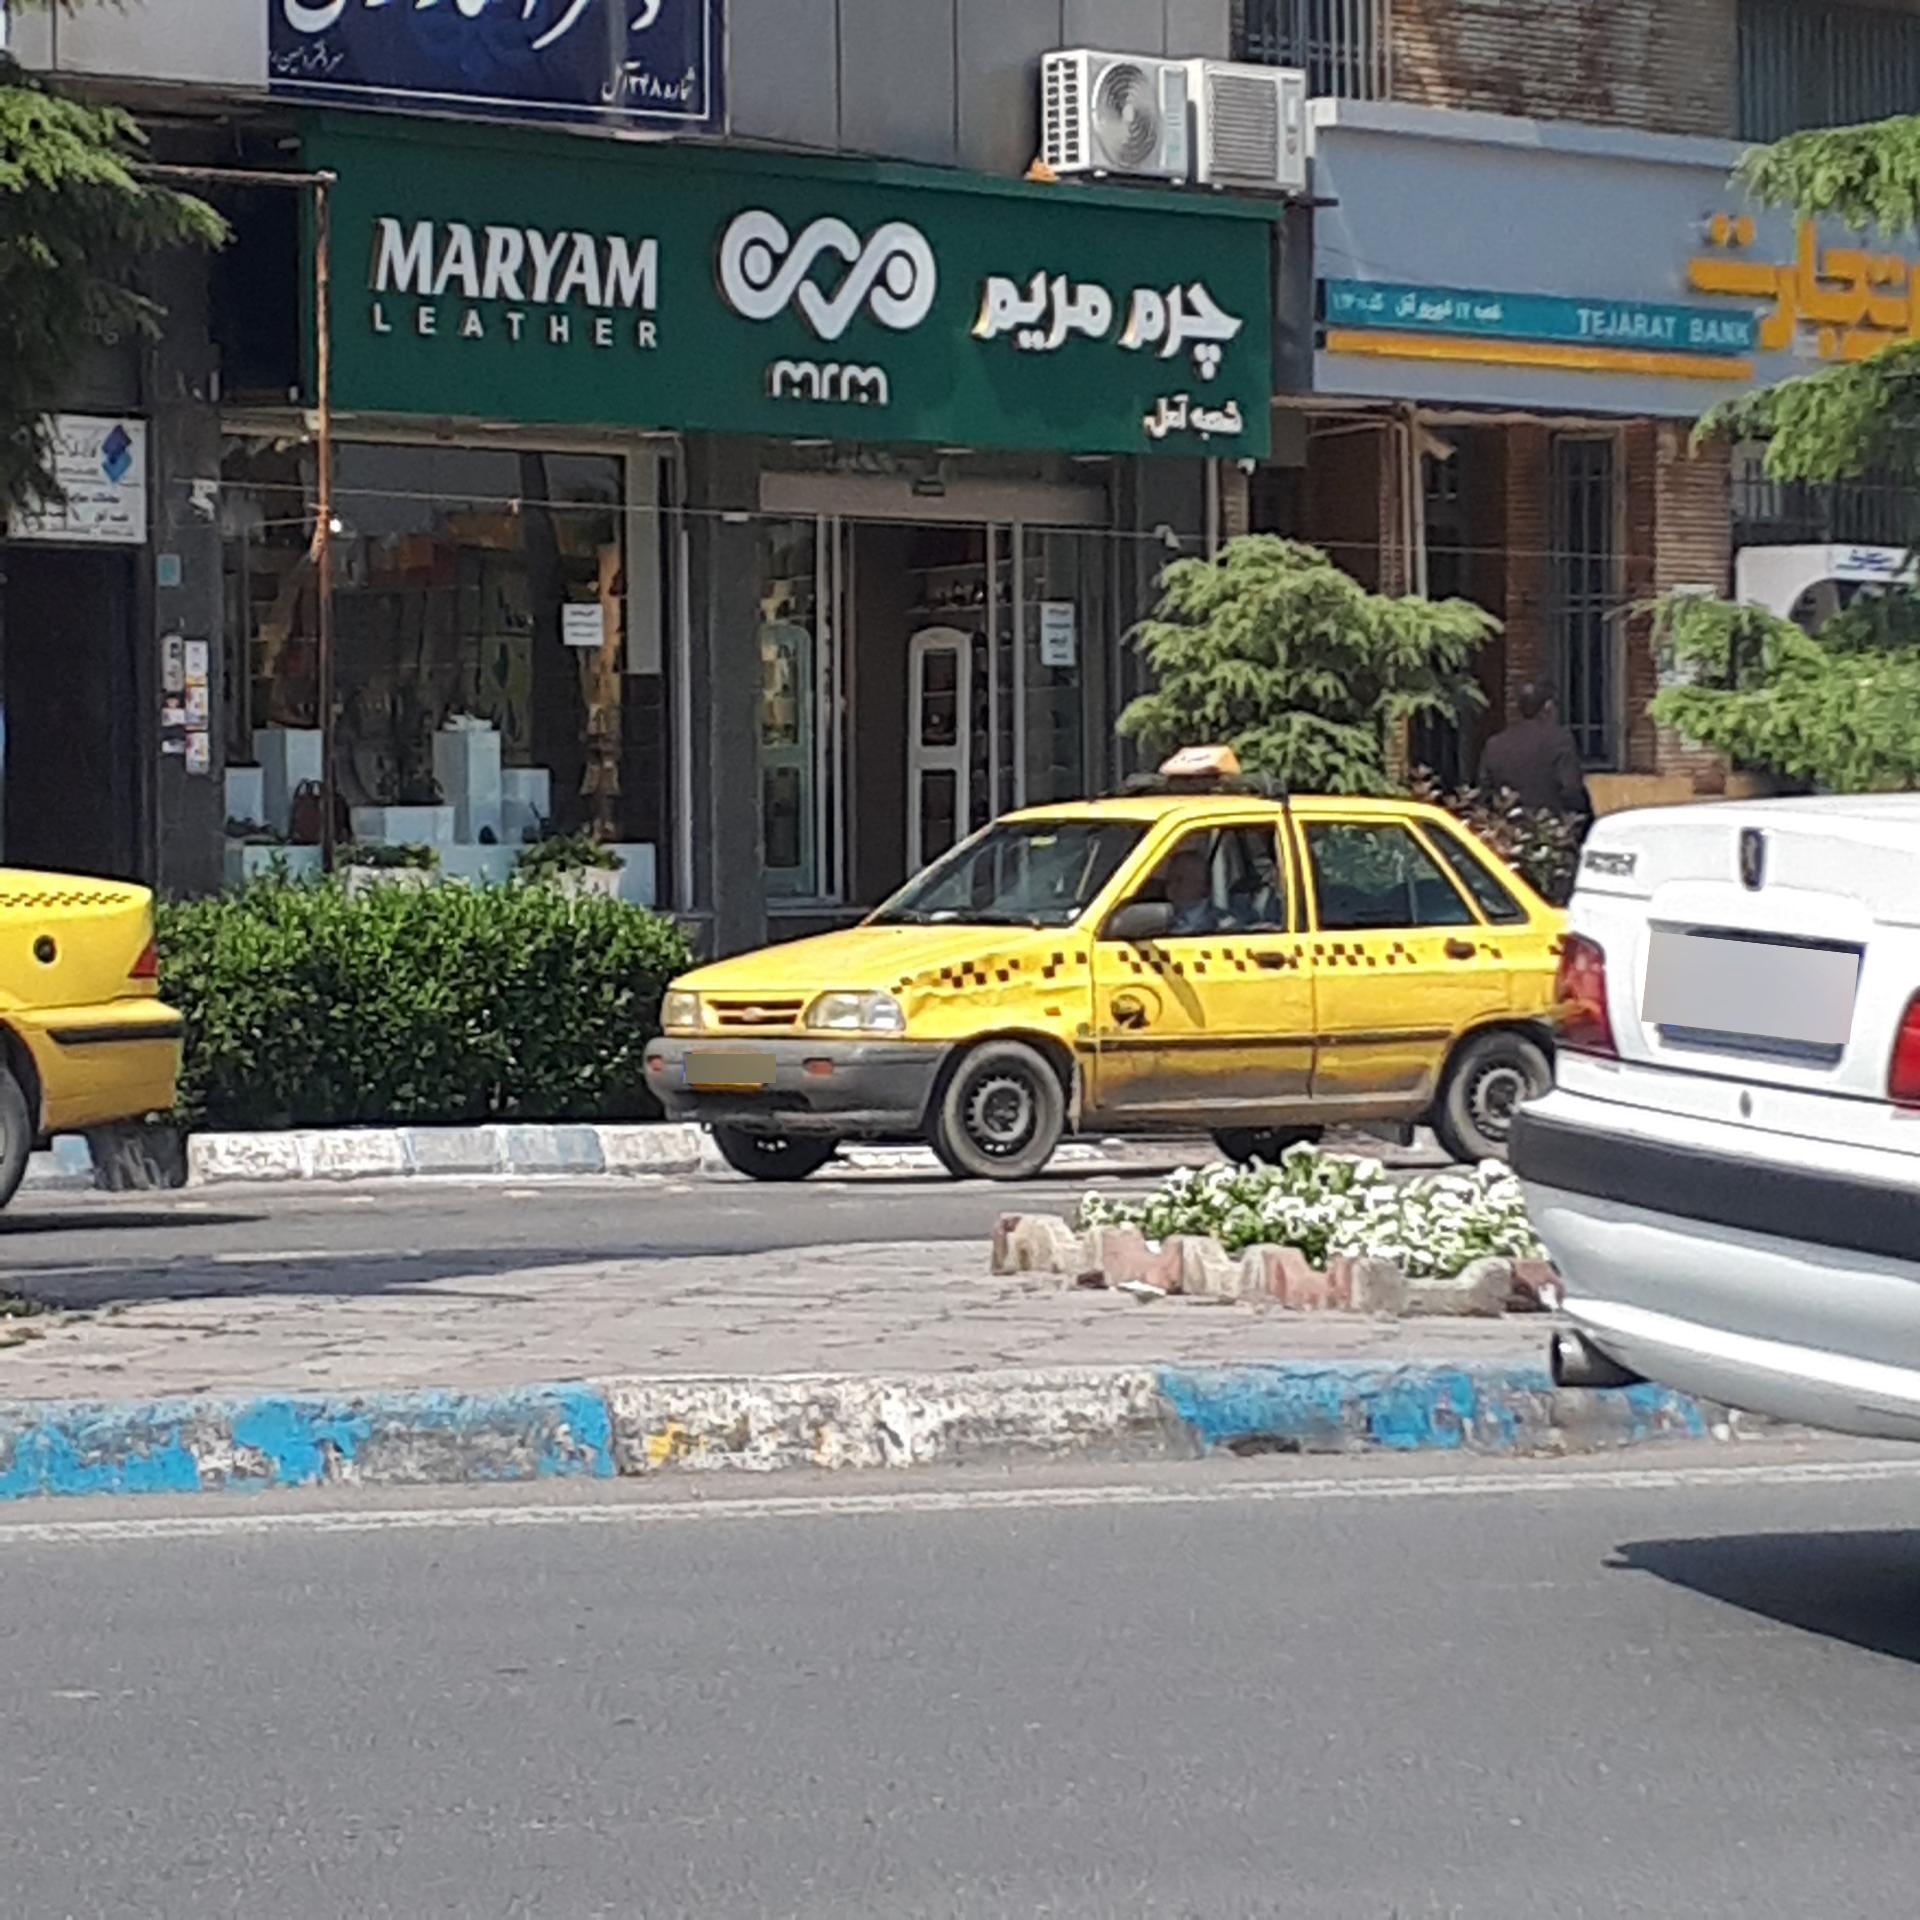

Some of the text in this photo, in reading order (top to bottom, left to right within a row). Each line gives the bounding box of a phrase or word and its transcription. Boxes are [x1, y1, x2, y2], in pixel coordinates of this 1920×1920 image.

[374, 217, 658, 311] MARYAM
[373, 303, 658, 348] LEATHER
[970, 269, 1243, 380] چرم مریم
[1576, 307, 1750, 345] TEJARAT BANK
[1190, 399, 1243, 441] شعبه
